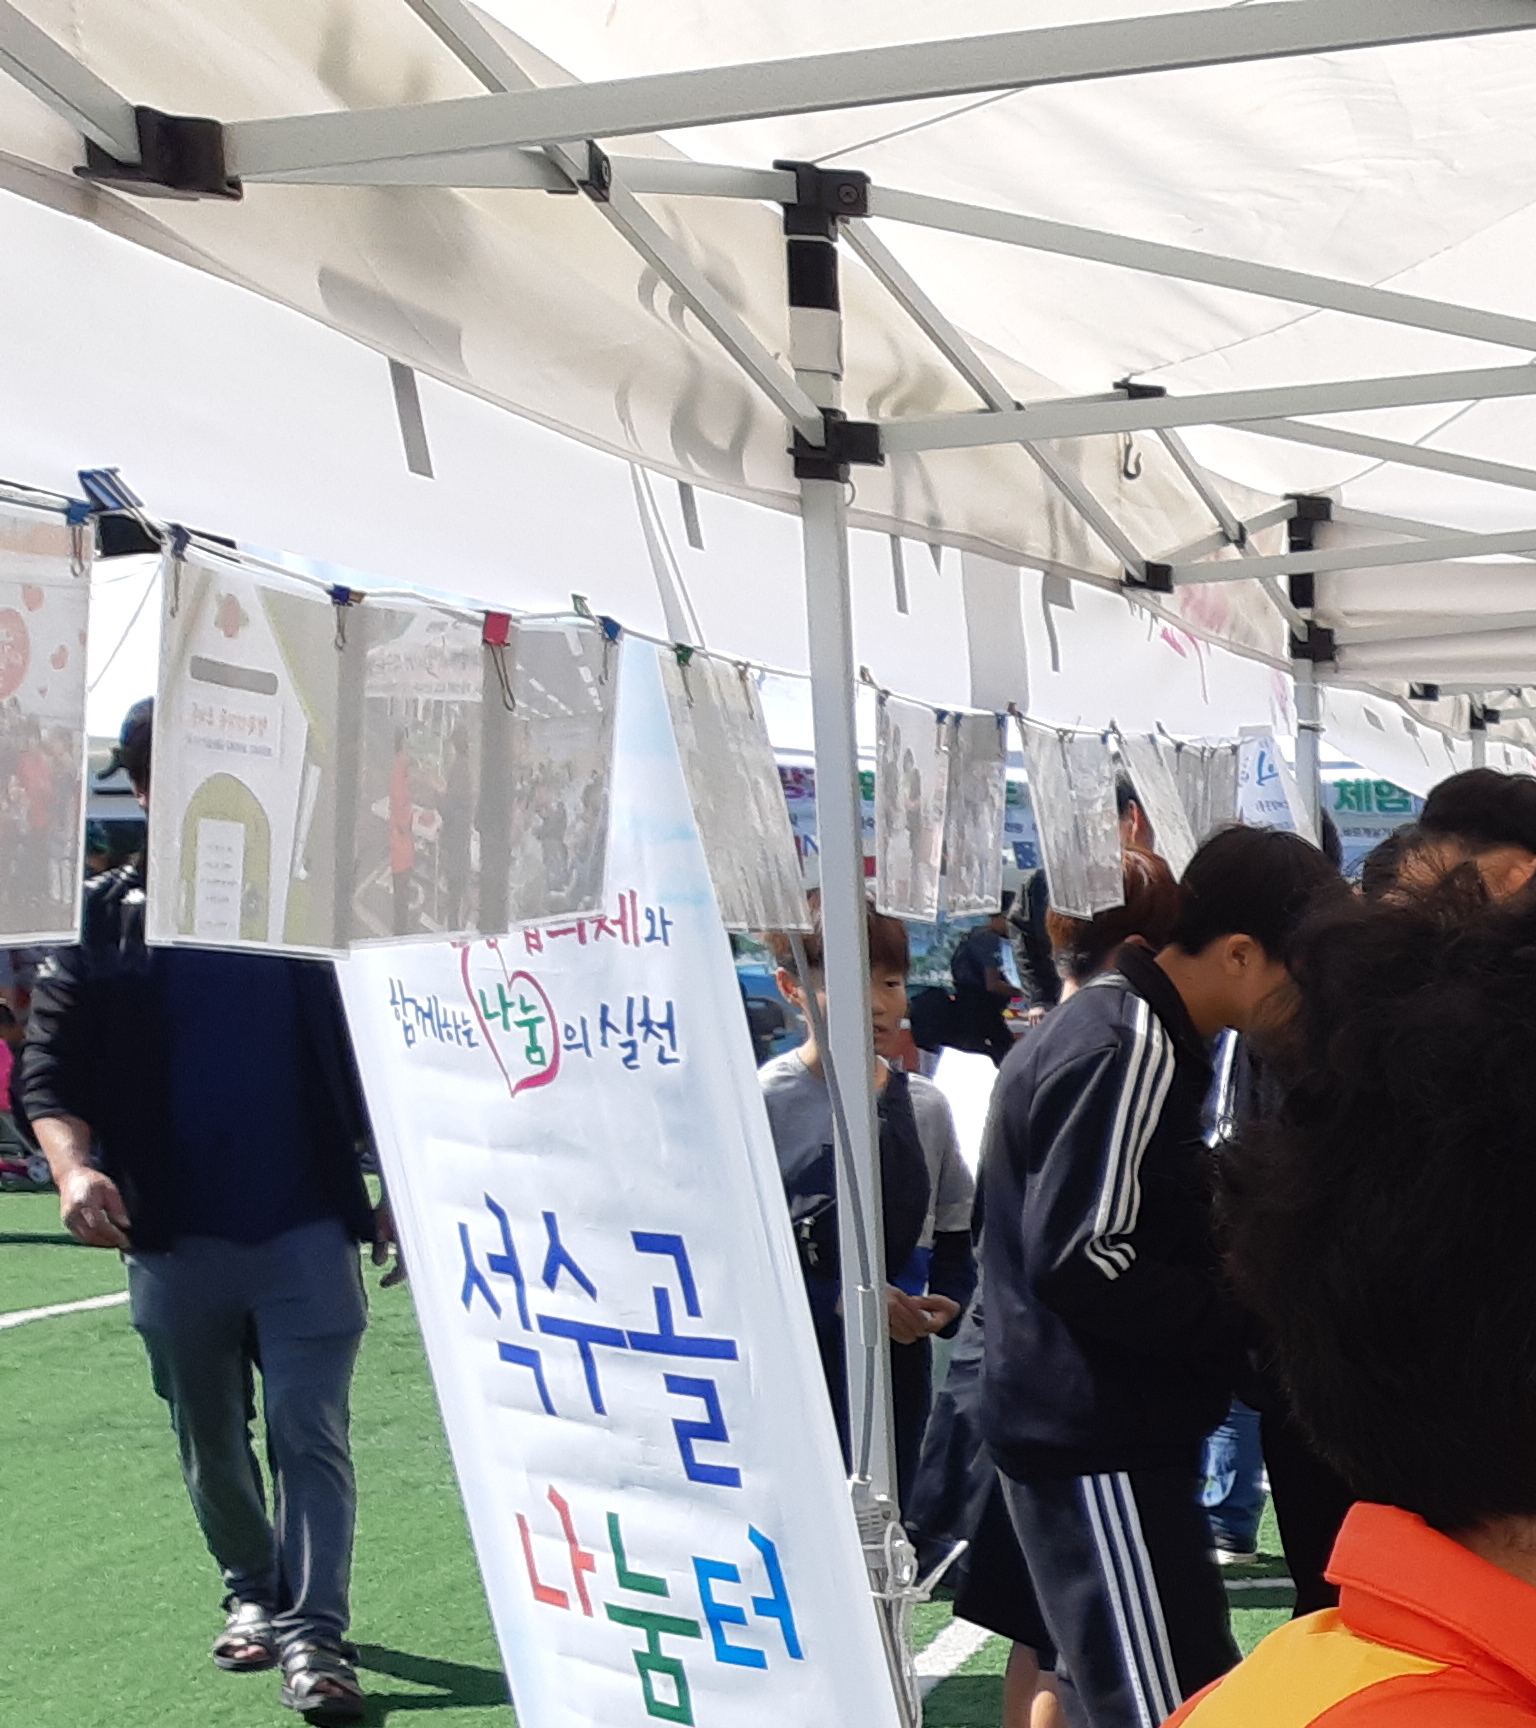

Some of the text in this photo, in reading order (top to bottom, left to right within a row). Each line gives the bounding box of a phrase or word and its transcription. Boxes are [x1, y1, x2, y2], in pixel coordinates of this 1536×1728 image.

[389, 977, 478, 1047] 함께하는
[600, 994, 680, 1069] 실천
[458, 1192, 742, 1488] 석수골
[516, 1484, 804, 1726] 나눔터
